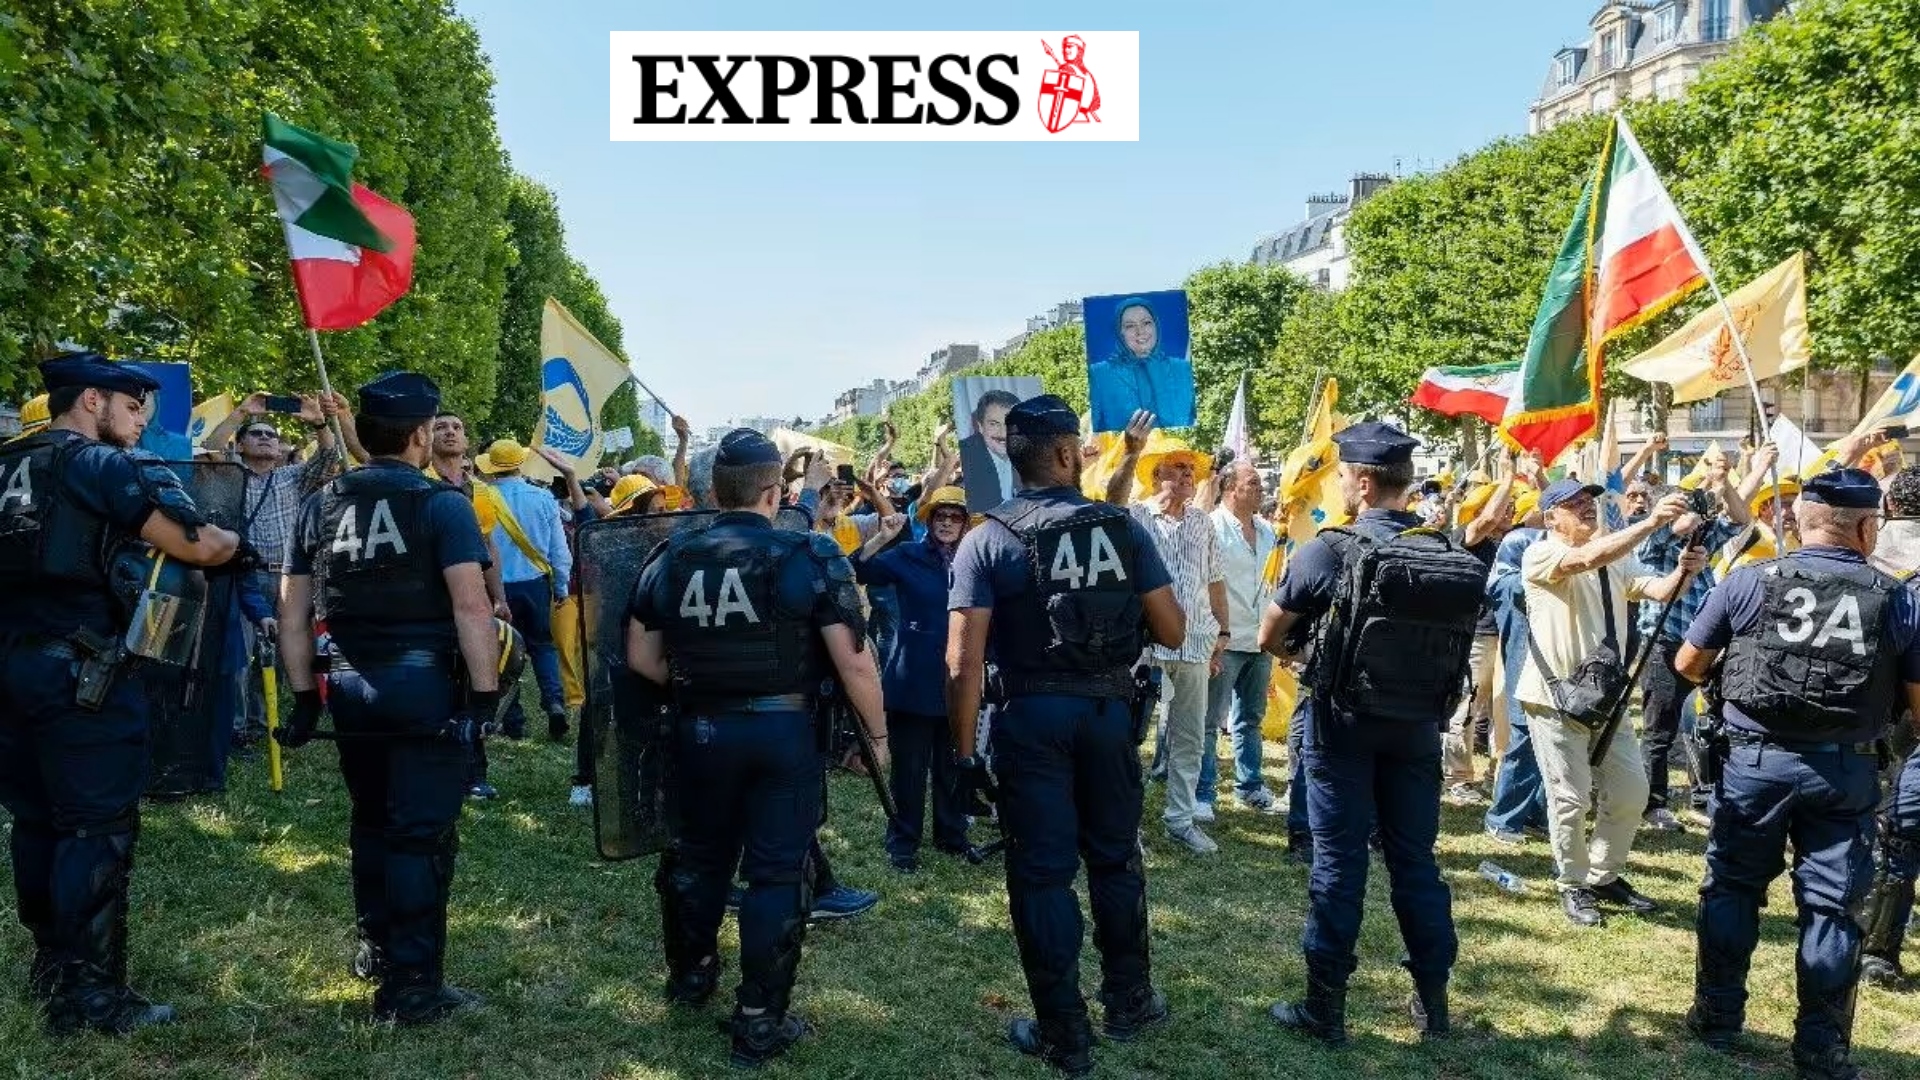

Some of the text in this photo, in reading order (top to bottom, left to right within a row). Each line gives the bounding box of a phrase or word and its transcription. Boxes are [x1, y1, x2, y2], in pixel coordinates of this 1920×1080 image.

[0, 456, 32, 511] A
[332, 499, 407, 562] 4A
[1050, 526, 1127, 589] 4A
[680, 568, 760, 627] 4A
[1777, 586, 1867, 656] 3A
